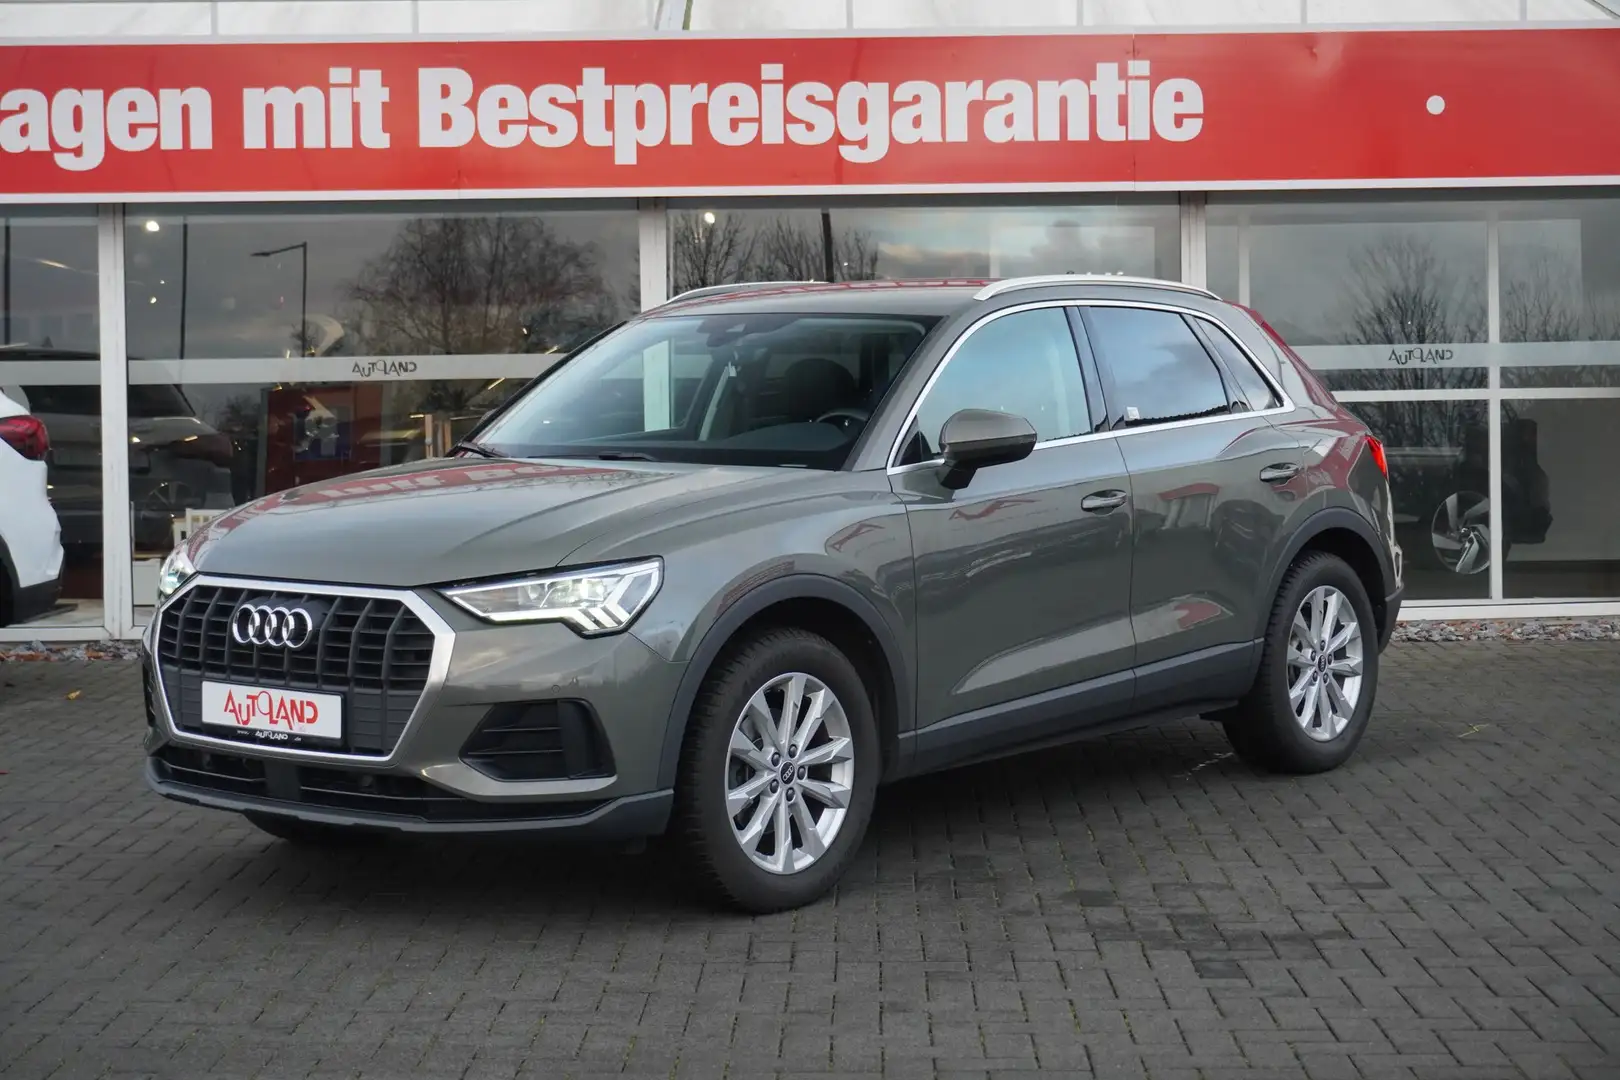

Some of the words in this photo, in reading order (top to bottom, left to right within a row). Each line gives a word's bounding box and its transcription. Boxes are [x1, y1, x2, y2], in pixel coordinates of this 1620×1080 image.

[0, 87, 213, 171] agen
[243, 67, 390, 149] mit
[418, 60, 1204, 165] Bestpreisgarantie
